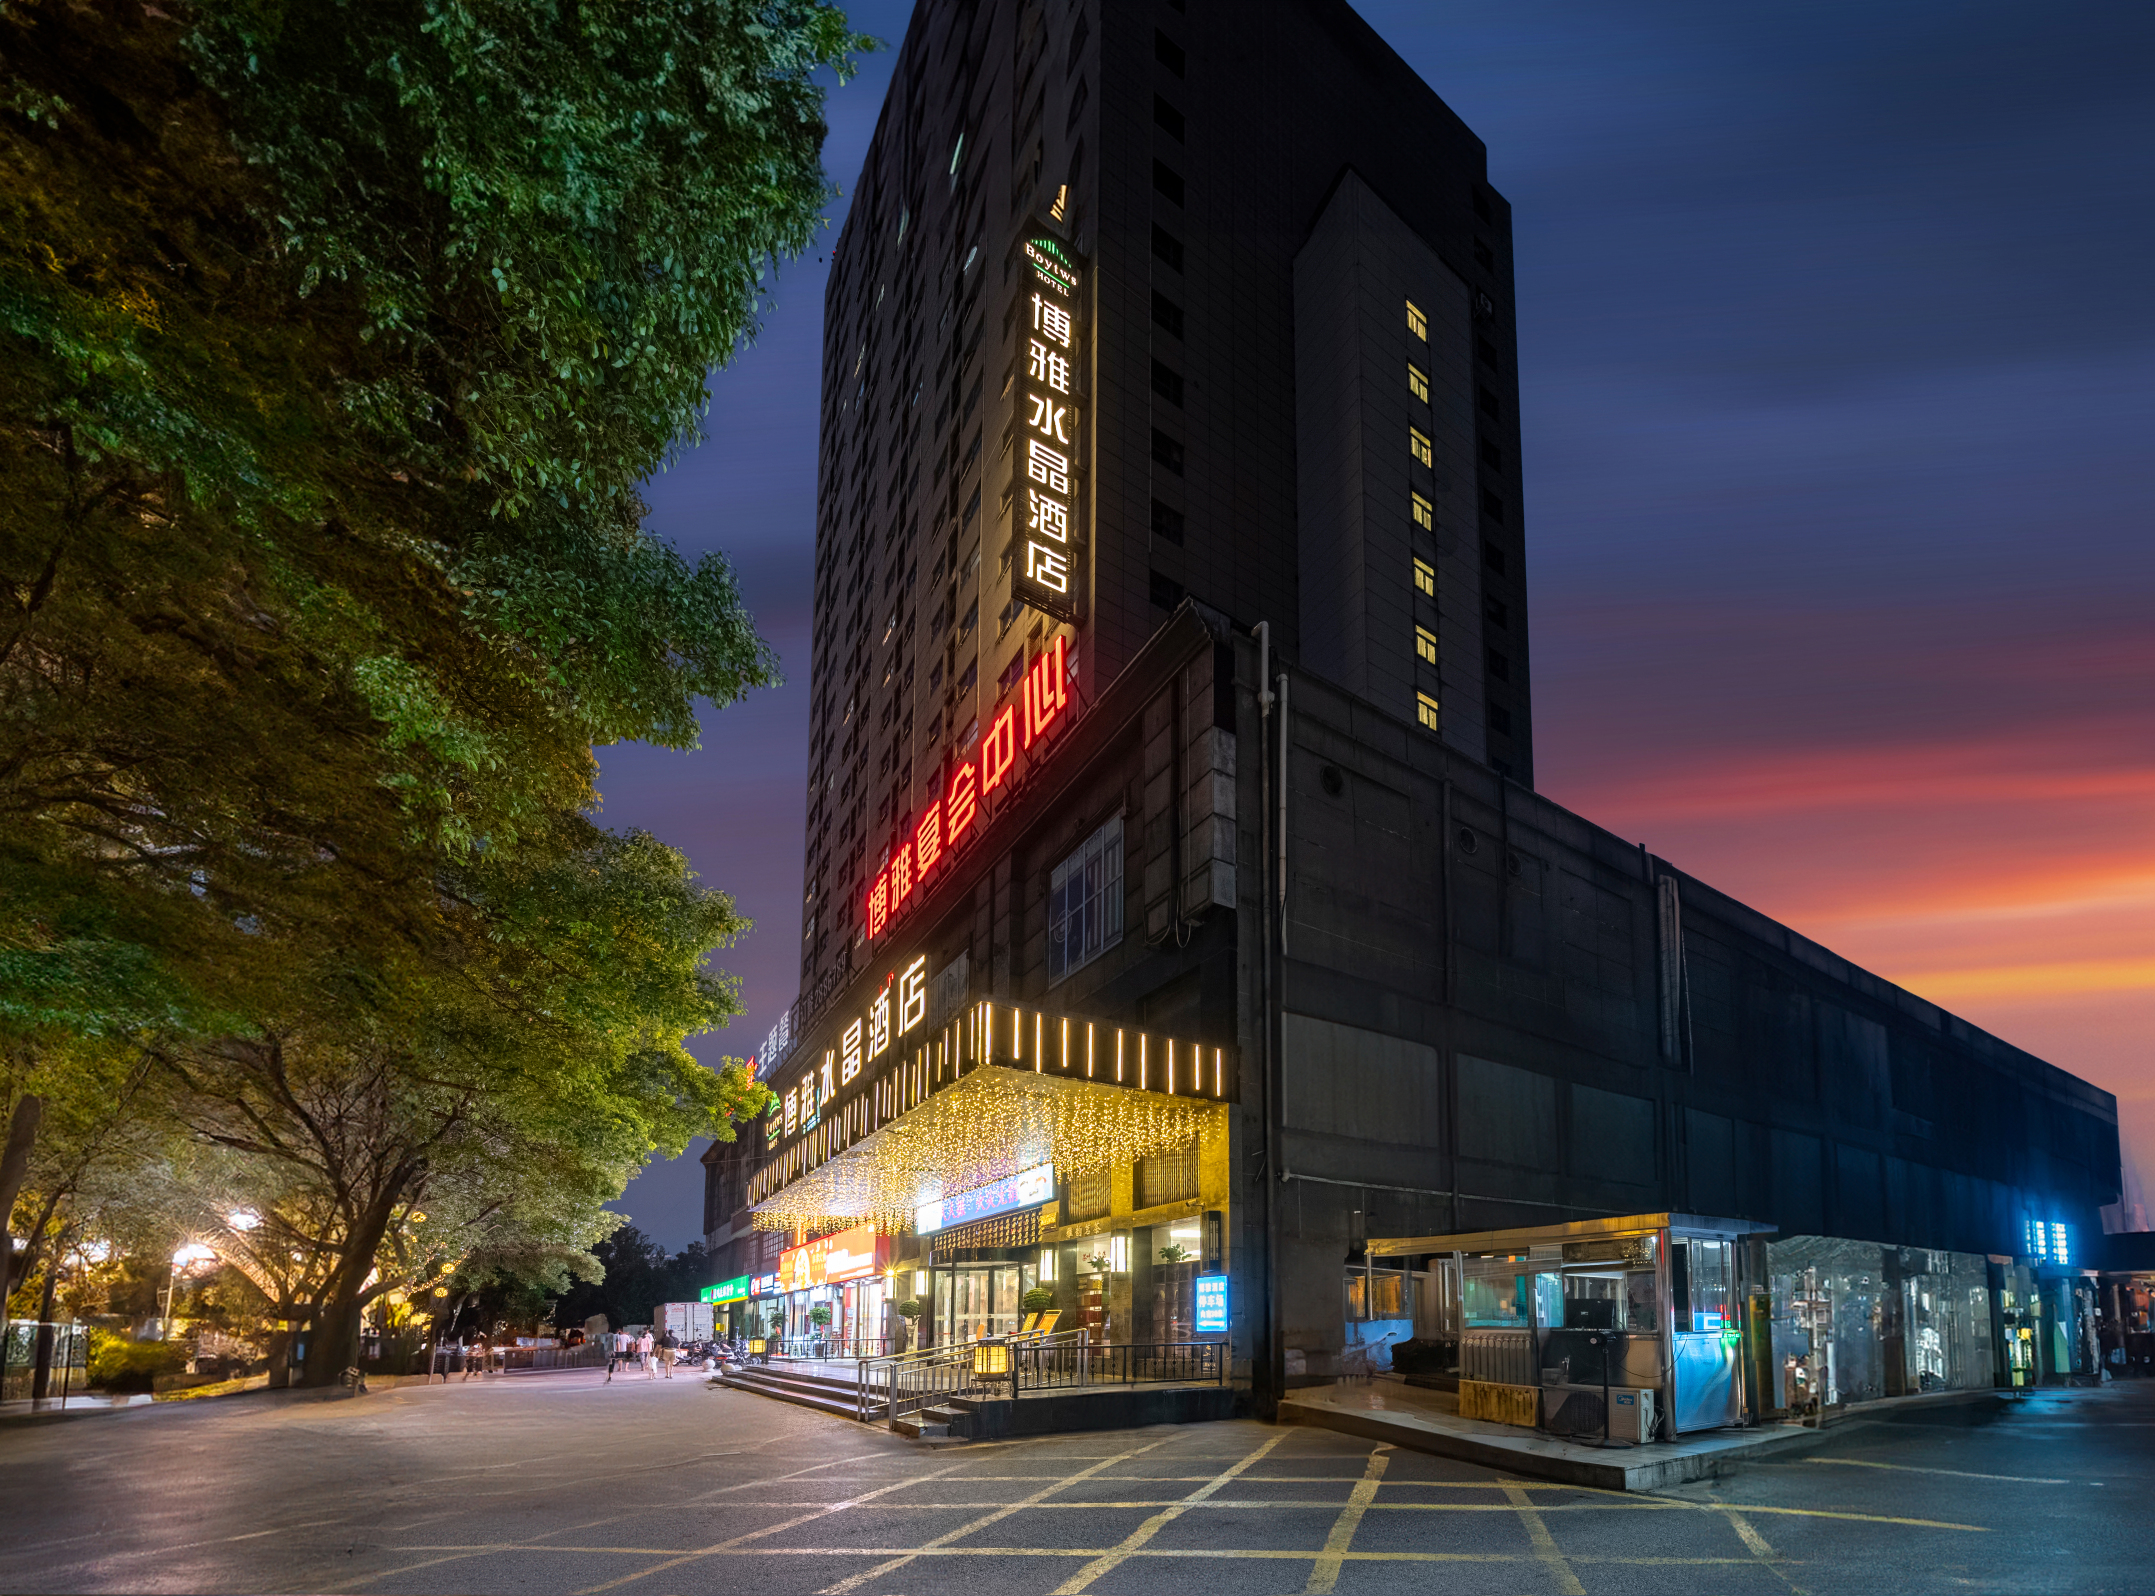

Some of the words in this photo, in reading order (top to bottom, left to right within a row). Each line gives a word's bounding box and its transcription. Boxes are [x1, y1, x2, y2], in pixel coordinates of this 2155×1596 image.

[1036, 270, 1069, 297] HOTEL
[1026, 292, 1072, 594] 博雅水晶酒店
[867, 634, 1068, 941] 博雅宴会中心
[783, 954, 926, 1139] 博雅水晶酒店
[1198, 1294, 1225, 1308] 停车场
